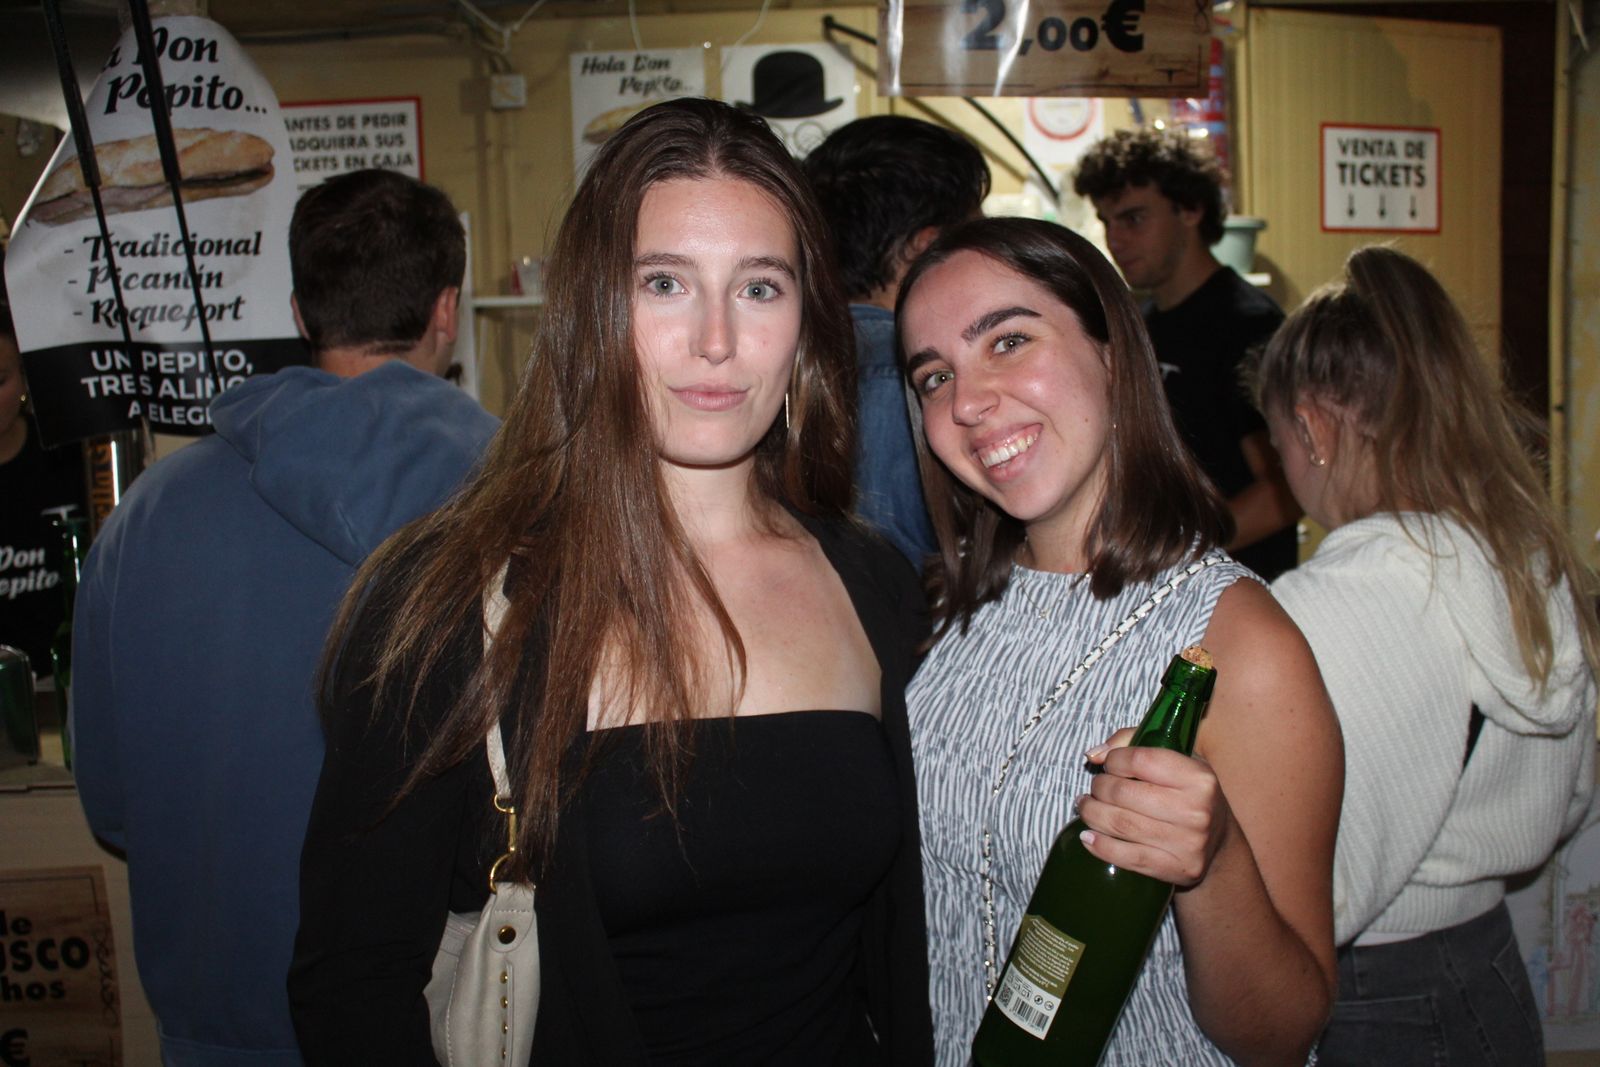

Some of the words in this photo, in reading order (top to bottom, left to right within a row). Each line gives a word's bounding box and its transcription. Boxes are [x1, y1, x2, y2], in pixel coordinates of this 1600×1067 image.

[581, 56, 625, 75] Hola
[633, 55, 670, 72] Don
[337, 115, 355, 129] DE
[362, 113, 406, 127] PEDIR
[375, 133, 404, 148] SUS
[1338, 138, 1397, 157] VENTA
[1405, 141, 1425, 159] DE
[345, 156, 365, 168] EN
[372, 153, 413, 168] CAJA
[1337, 162, 1426, 188] TICKETS
[83, 231, 262, 262] Tradicional
[92, 296, 245, 331] Roquefort
[91, 350, 132, 371] UN
[141, 349, 254, 375] PEPITO,
[80, 373, 153, 398] TRES
[128, 400, 142, 419] A
